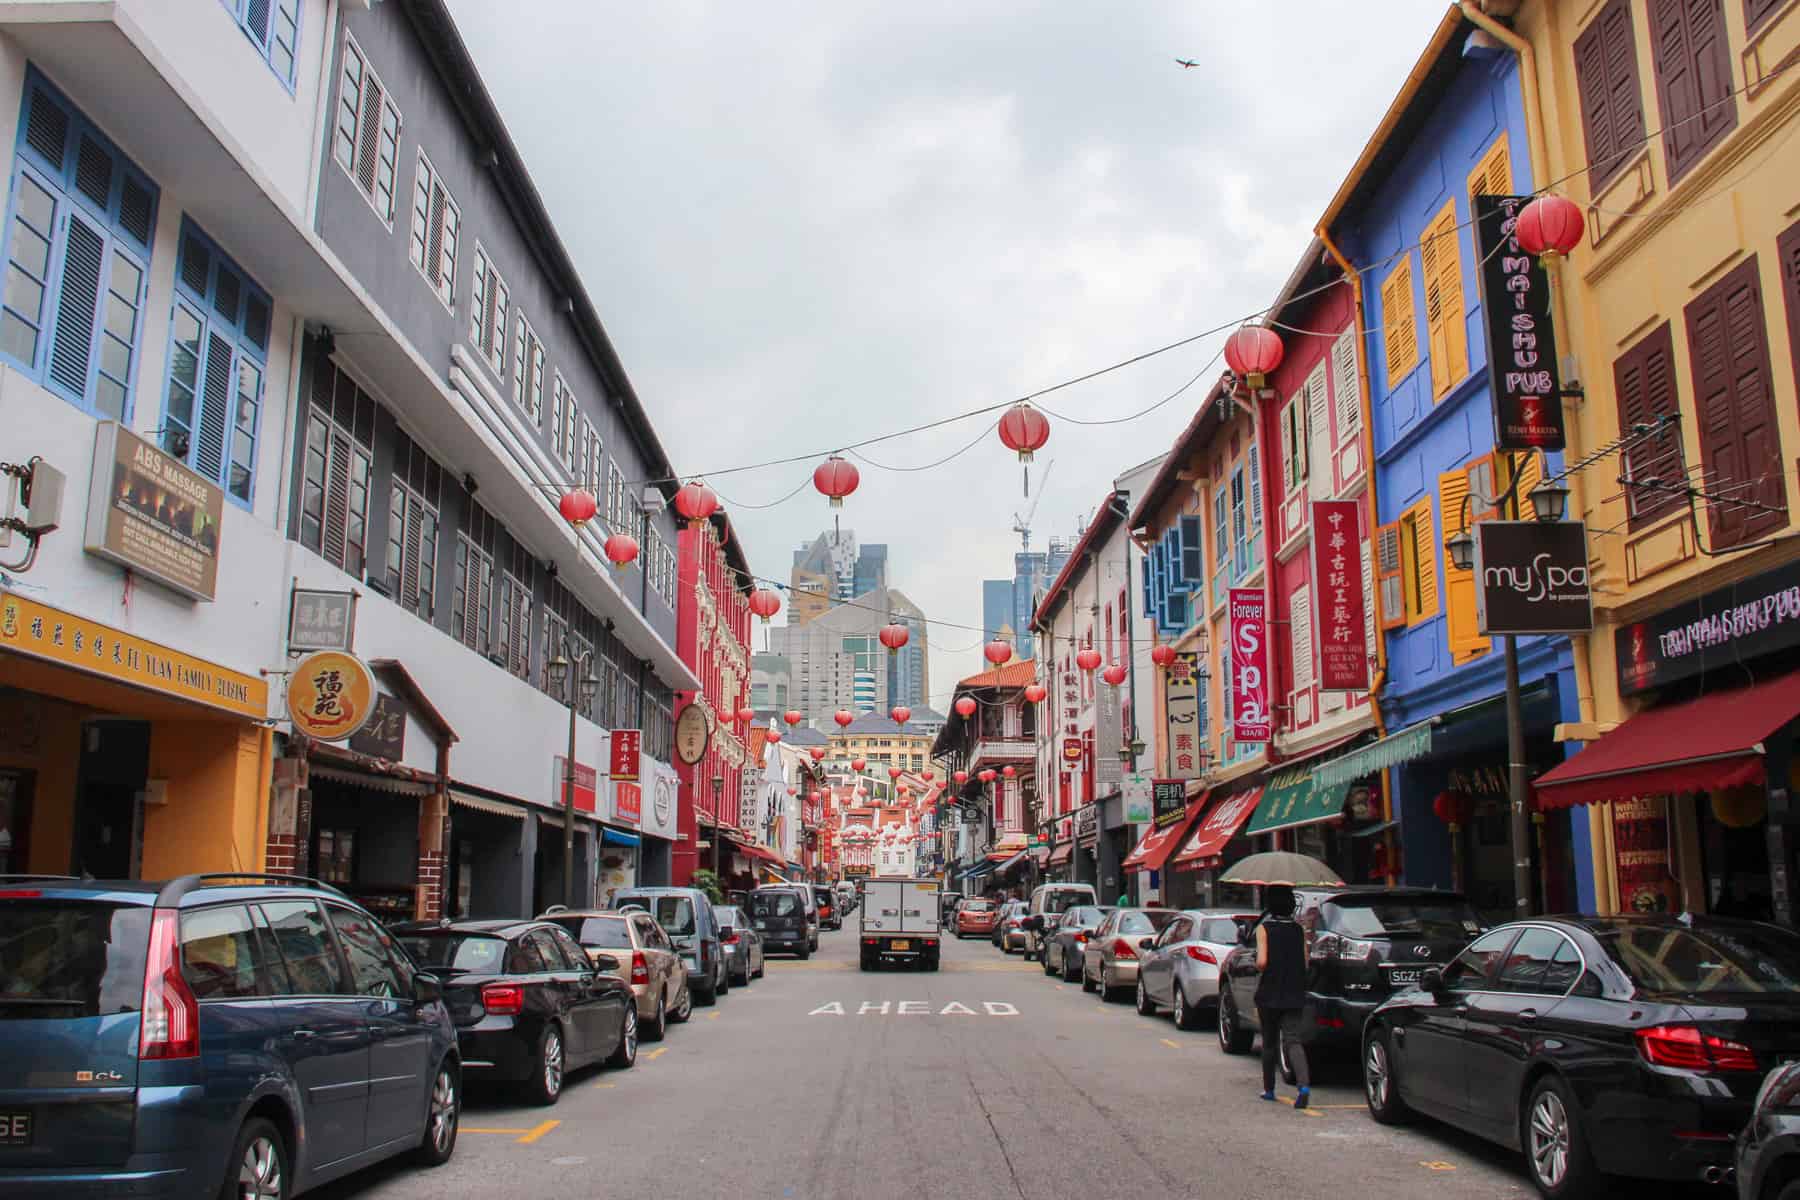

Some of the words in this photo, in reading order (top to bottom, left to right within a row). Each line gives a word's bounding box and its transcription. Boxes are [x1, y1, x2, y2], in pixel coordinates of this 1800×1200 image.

[1505, 371, 1552, 394] PUB
[133, 443, 161, 473] ABS
[163, 464, 208, 503] MASSAGE
[1232, 602, 1264, 618] Forever
[1759, 586, 1800, 629] PUB
[145, 654, 172, 680] YUAN
[177, 664, 212, 691] FAMILY
[217, 678, 248, 704] CUISINE
[313, 670, 343, 716] 福苑
[1155, 784, 1184, 800] 有机
[808, 1001, 1020, 1016] AHEAD
